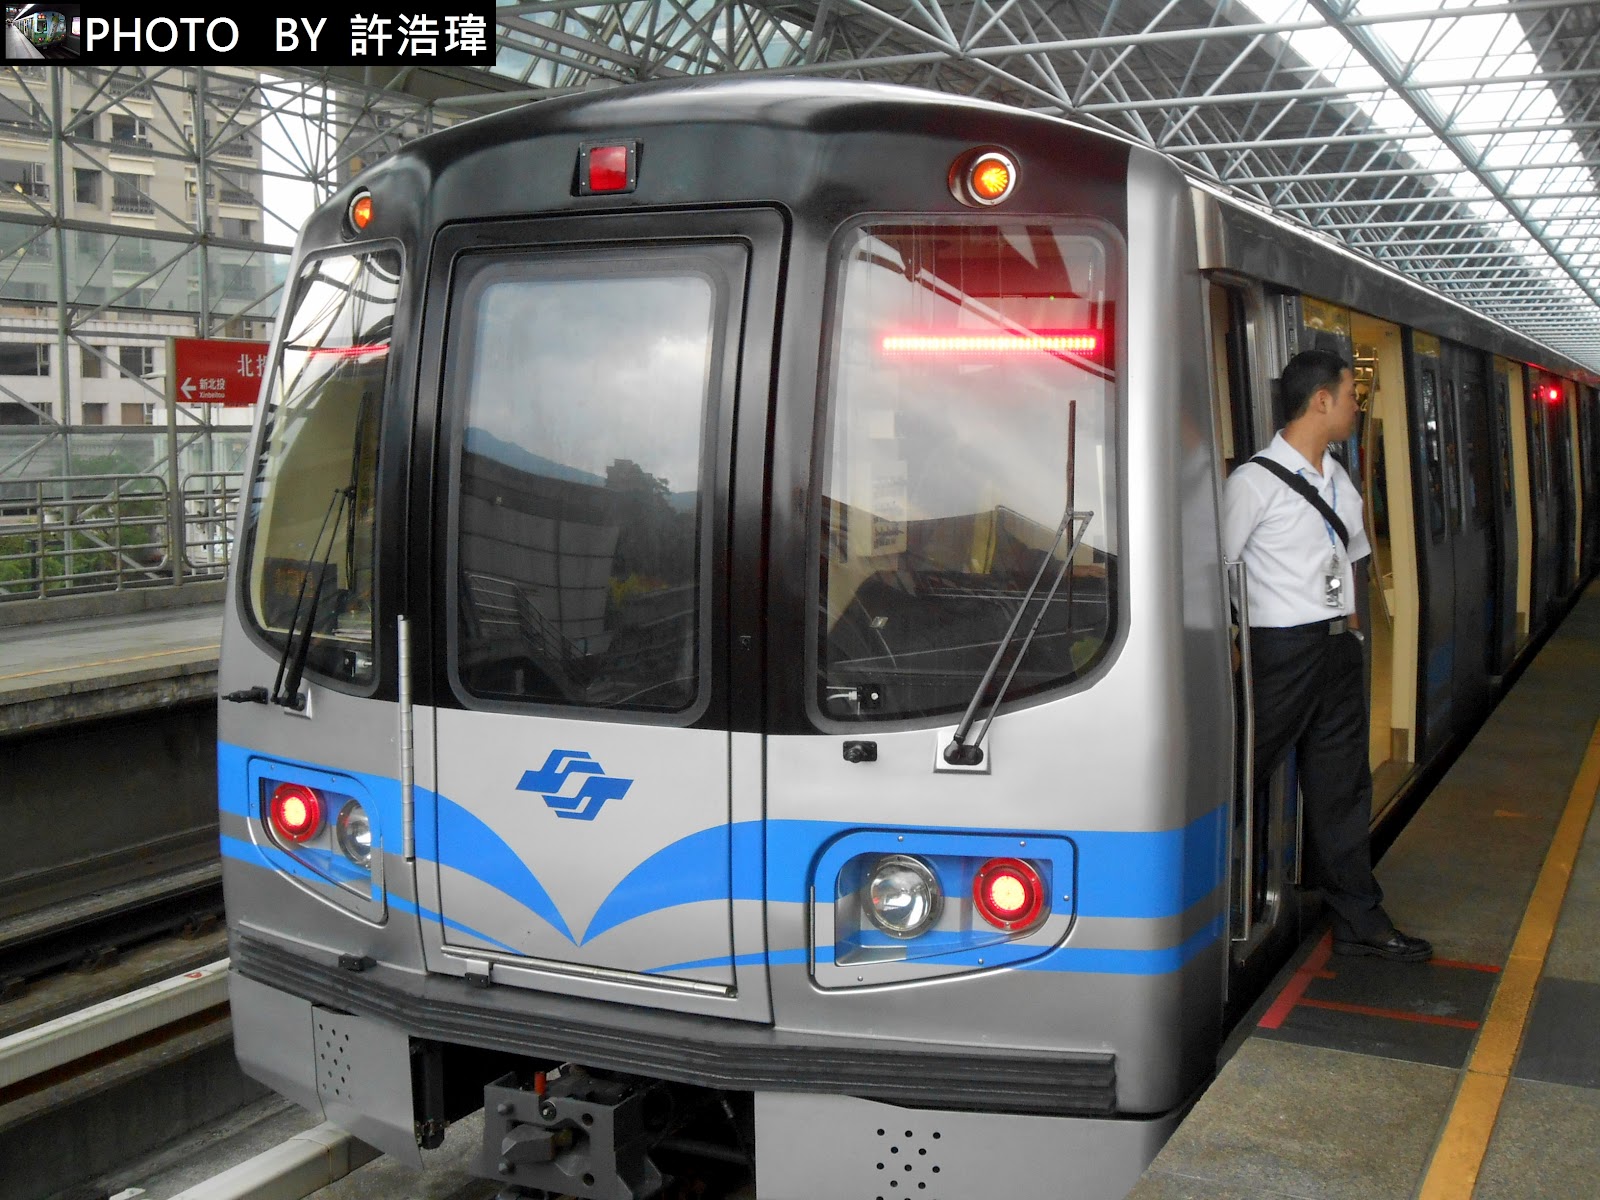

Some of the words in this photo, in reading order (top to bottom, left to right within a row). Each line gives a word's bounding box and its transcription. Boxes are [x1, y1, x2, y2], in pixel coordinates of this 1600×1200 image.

[199, 378, 226, 390] 新北投
[199, 391, 226, 399] Xinbeitou
